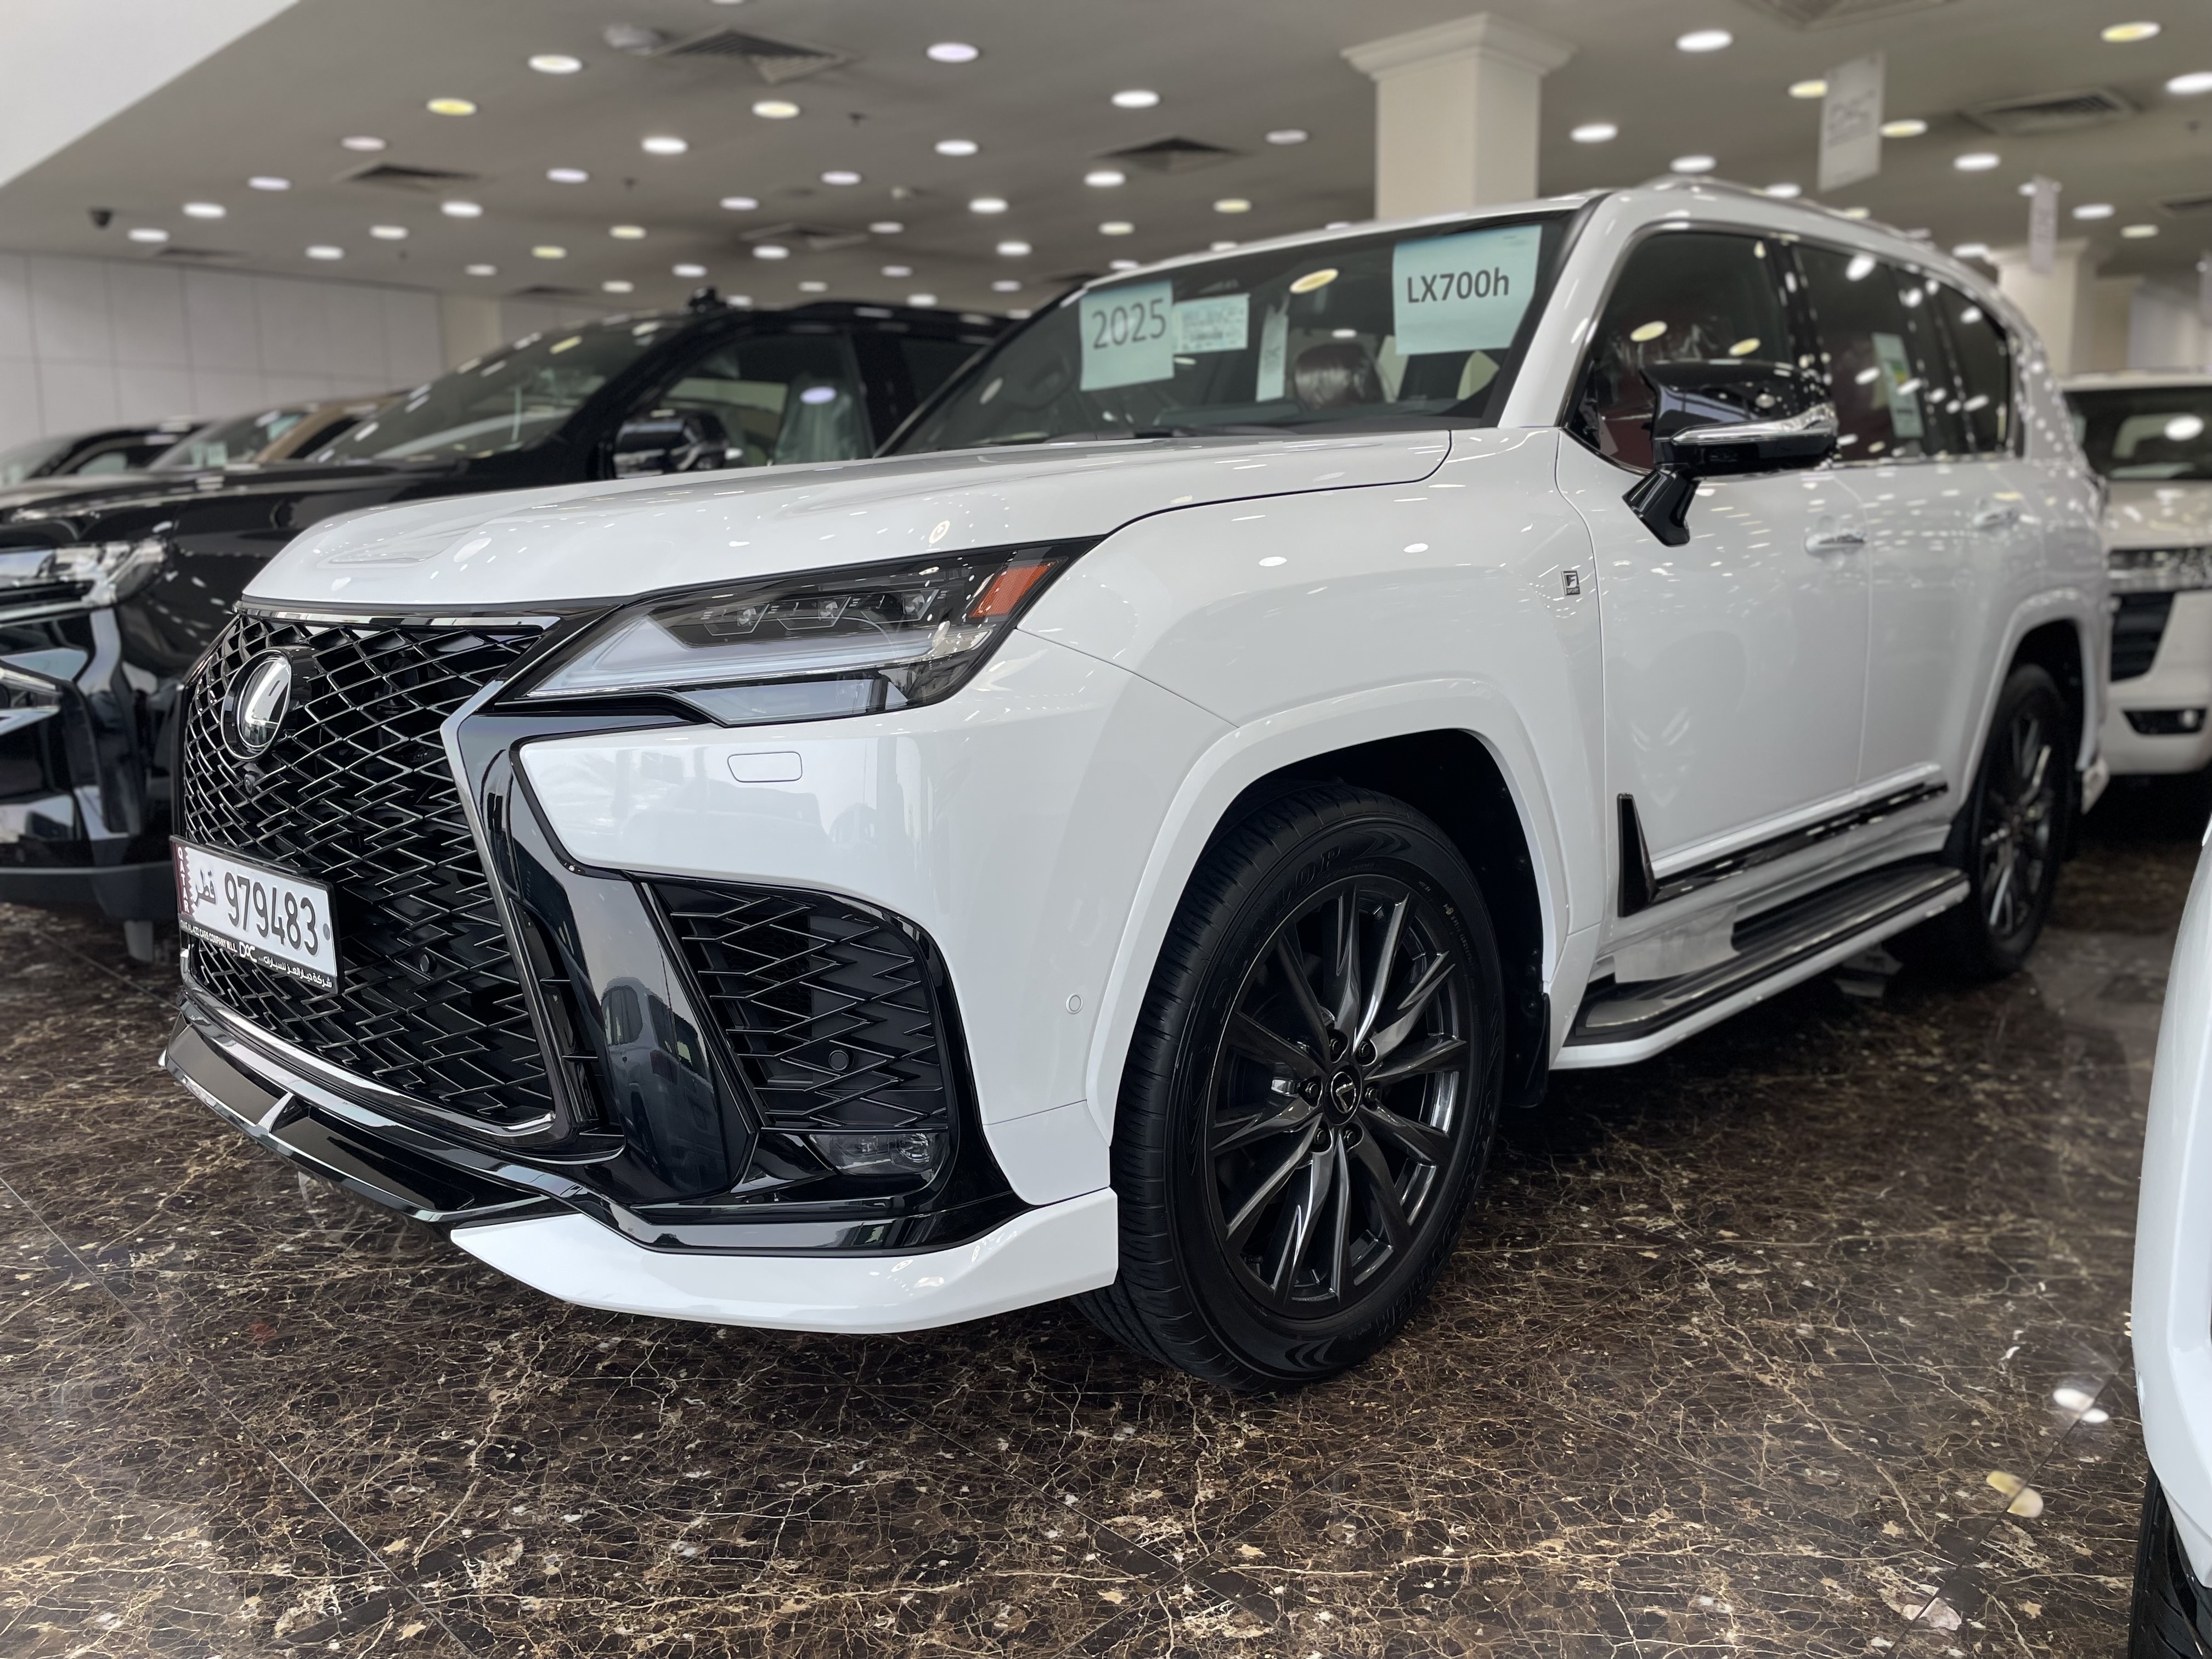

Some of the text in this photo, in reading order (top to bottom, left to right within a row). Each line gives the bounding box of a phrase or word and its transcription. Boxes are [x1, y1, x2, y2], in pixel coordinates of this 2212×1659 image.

[1407, 267, 1509, 303] LX700h
[1091, 297, 1166, 349] 2025
[178, 847, 189, 913] QATAR
[193, 868, 216, 907] قطر
[224, 871, 319, 956] 979483
